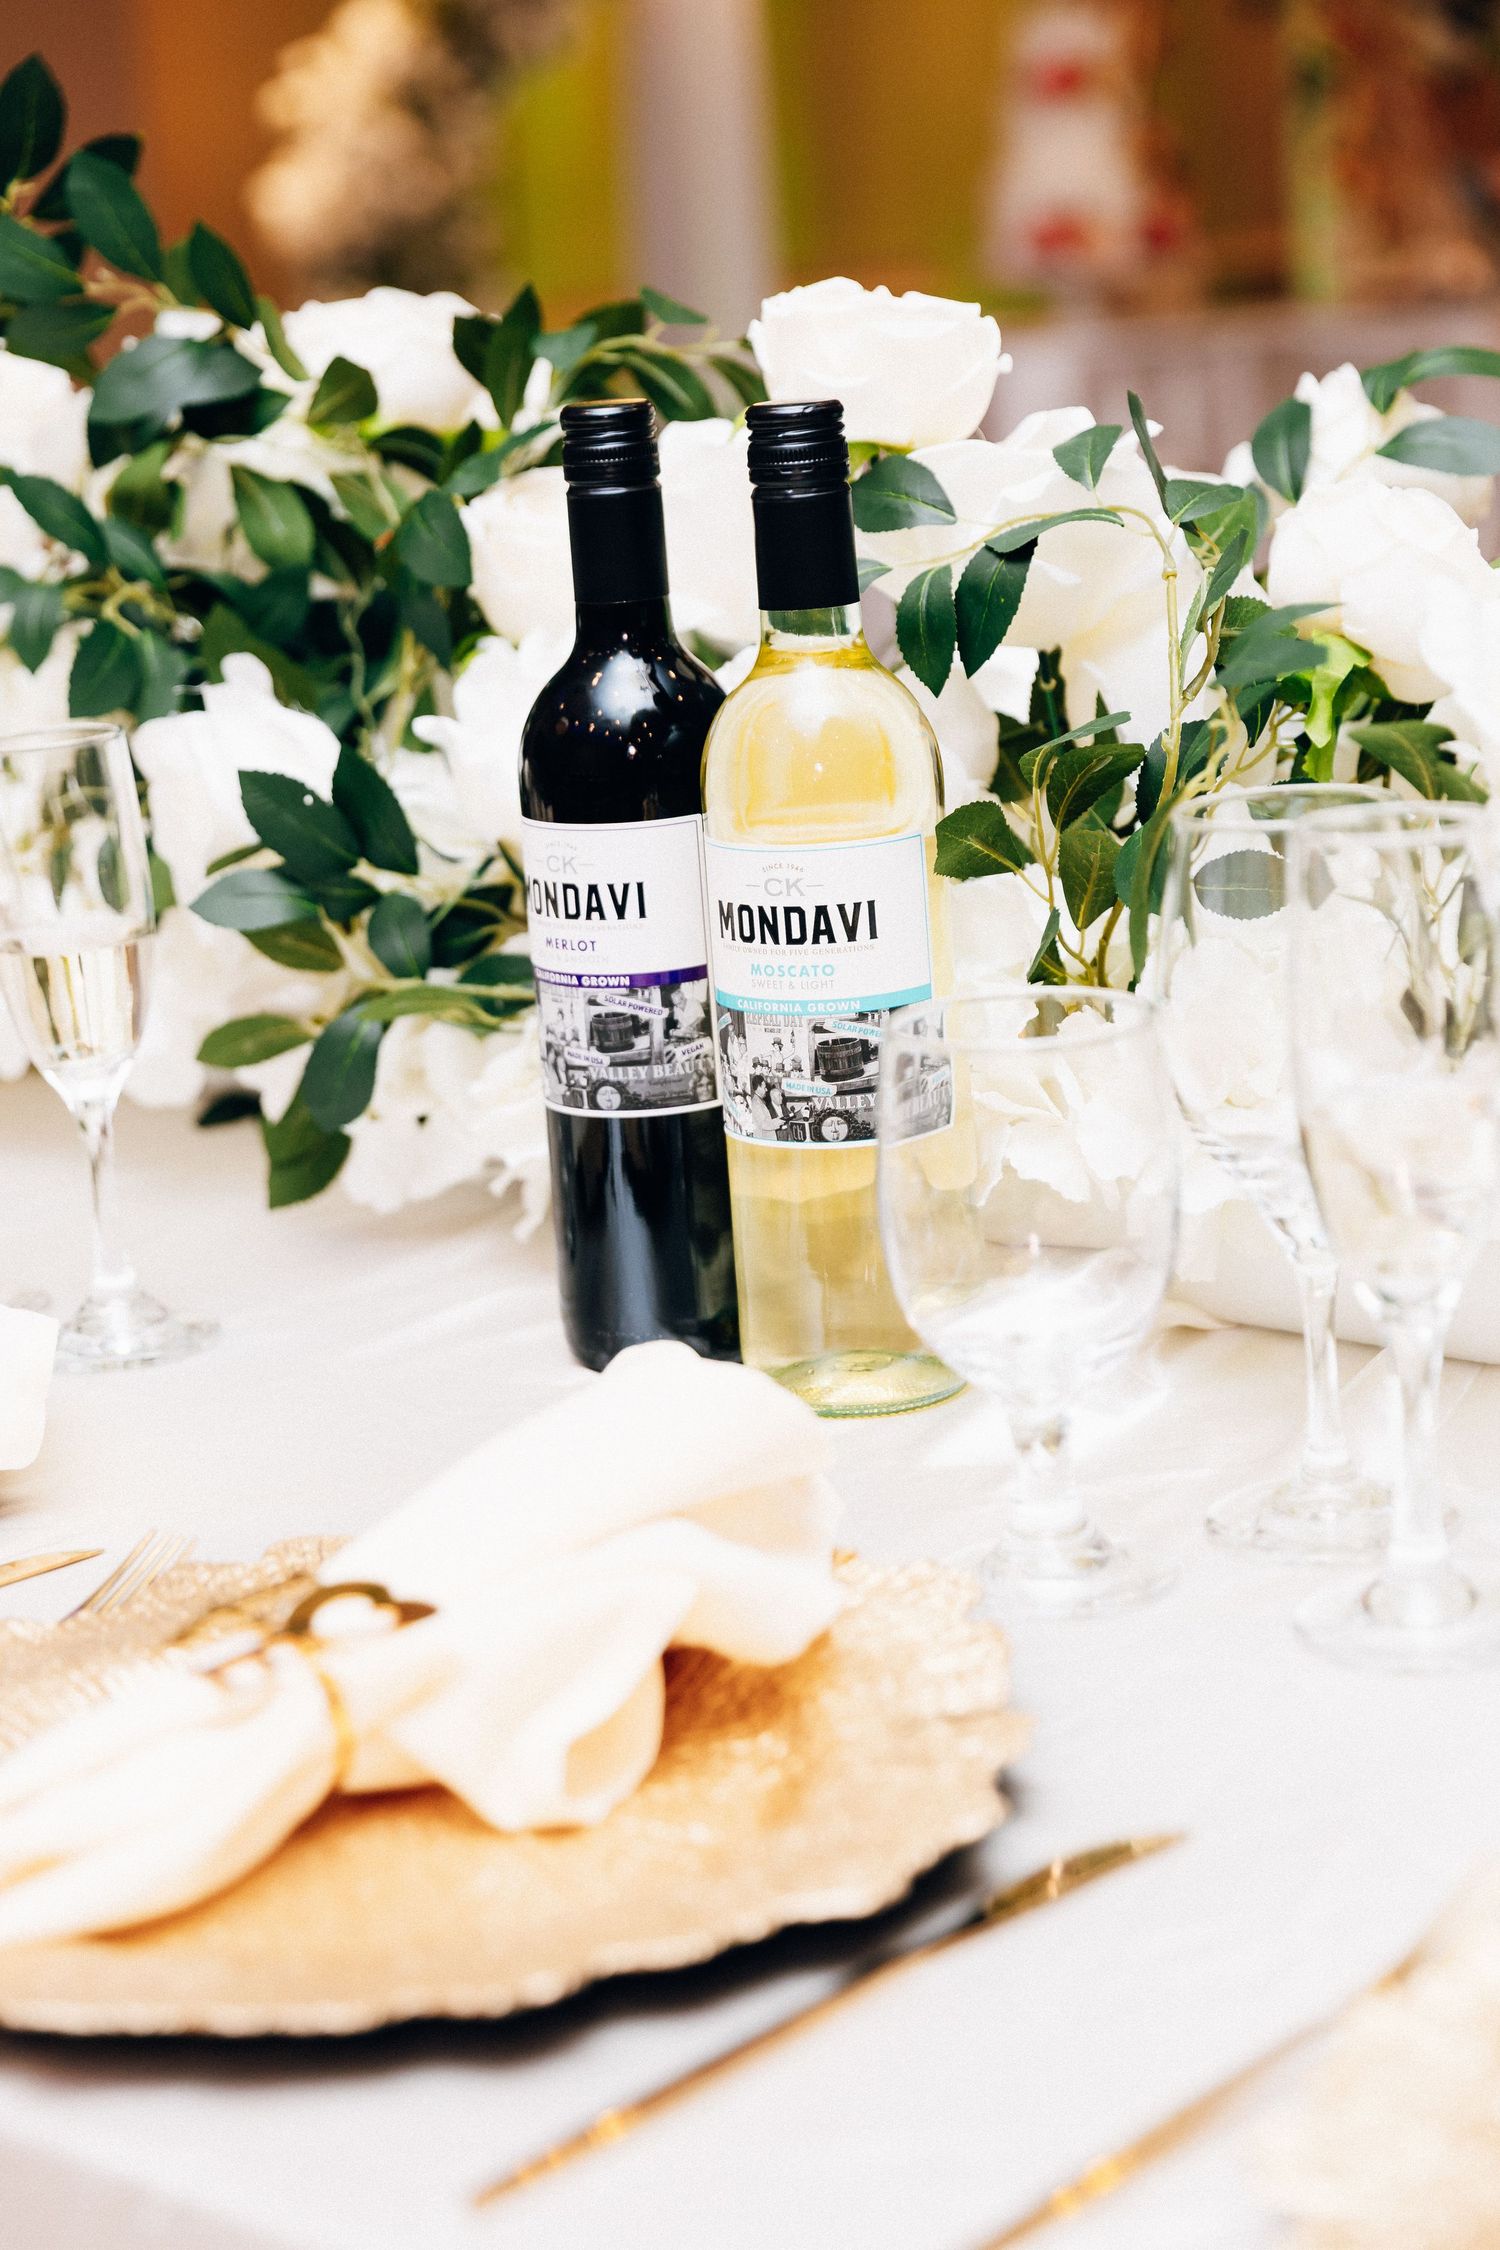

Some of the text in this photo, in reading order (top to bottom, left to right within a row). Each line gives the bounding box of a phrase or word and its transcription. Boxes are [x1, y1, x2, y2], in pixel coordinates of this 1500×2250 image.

[546, 855, 578, 875] CK
[763, 878, 807, 897] CK
[718, 899, 879, 946] MONDAVI
[545, 936, 598, 952] MERLOT
[742, 946, 769, 957] OWNED
[770, 948, 788, 957] FOR
[788, 948, 810, 958] FIVE
[811, 943, 877, 957] GENERATIONS
[751, 963, 836, 978] MOSCATO
[581, 976, 630, 987] GROWN
[751, 979, 836, 991] SWEET & LIGHT
[604, 995, 664, 1016] SOLAR POWERED
[737, 999, 861, 1013] CALIFORNIA GROWN
[831, 1020, 883, 1038] SOLAR POWE
[681, 1043, 704, 1056] VEGAN
[589, 1066, 649, 1081] VALLEY
[784, 1082, 832, 1096] MADE IN USA
[812, 1093, 878, 1110] VALLEY
